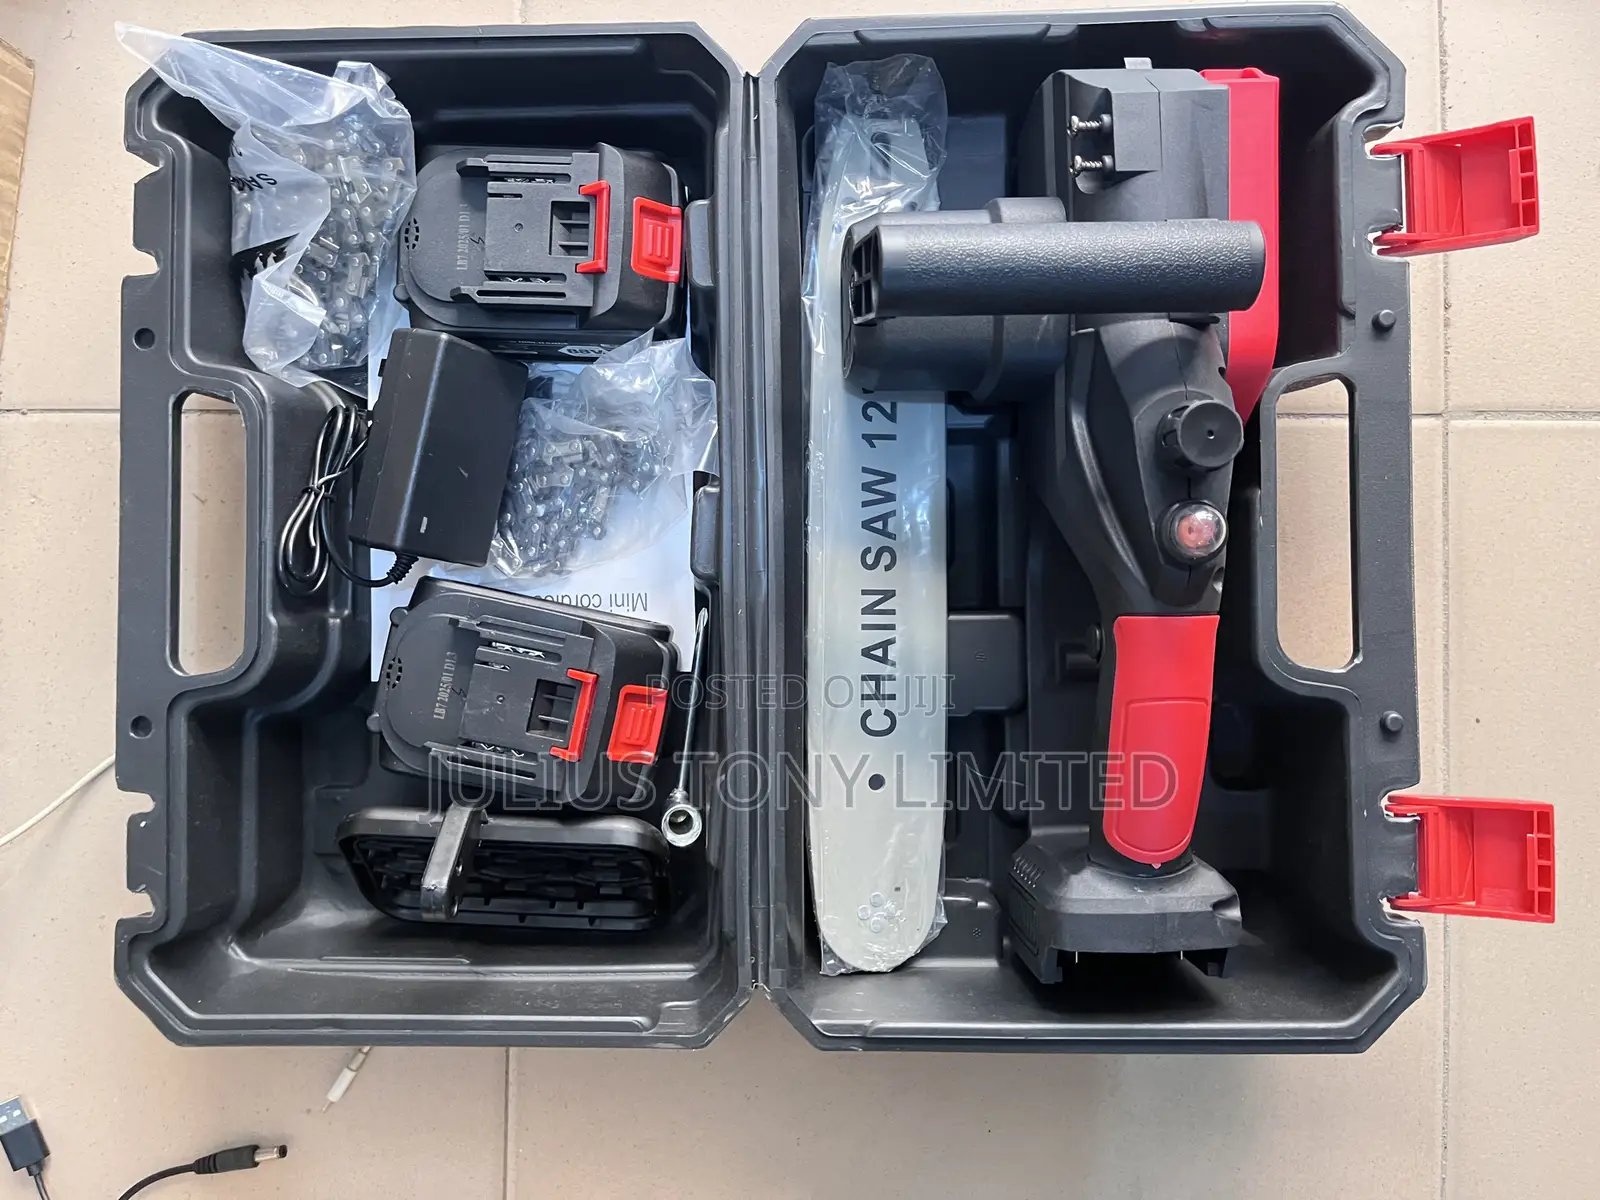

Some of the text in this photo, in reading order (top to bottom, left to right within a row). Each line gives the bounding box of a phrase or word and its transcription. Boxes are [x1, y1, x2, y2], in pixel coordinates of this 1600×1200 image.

[860, 467, 898, 572] SAW
[608, 592, 648, 612] Mini
[860, 588, 898, 738] CHAIN
[433, 703, 448, 720] LB7
